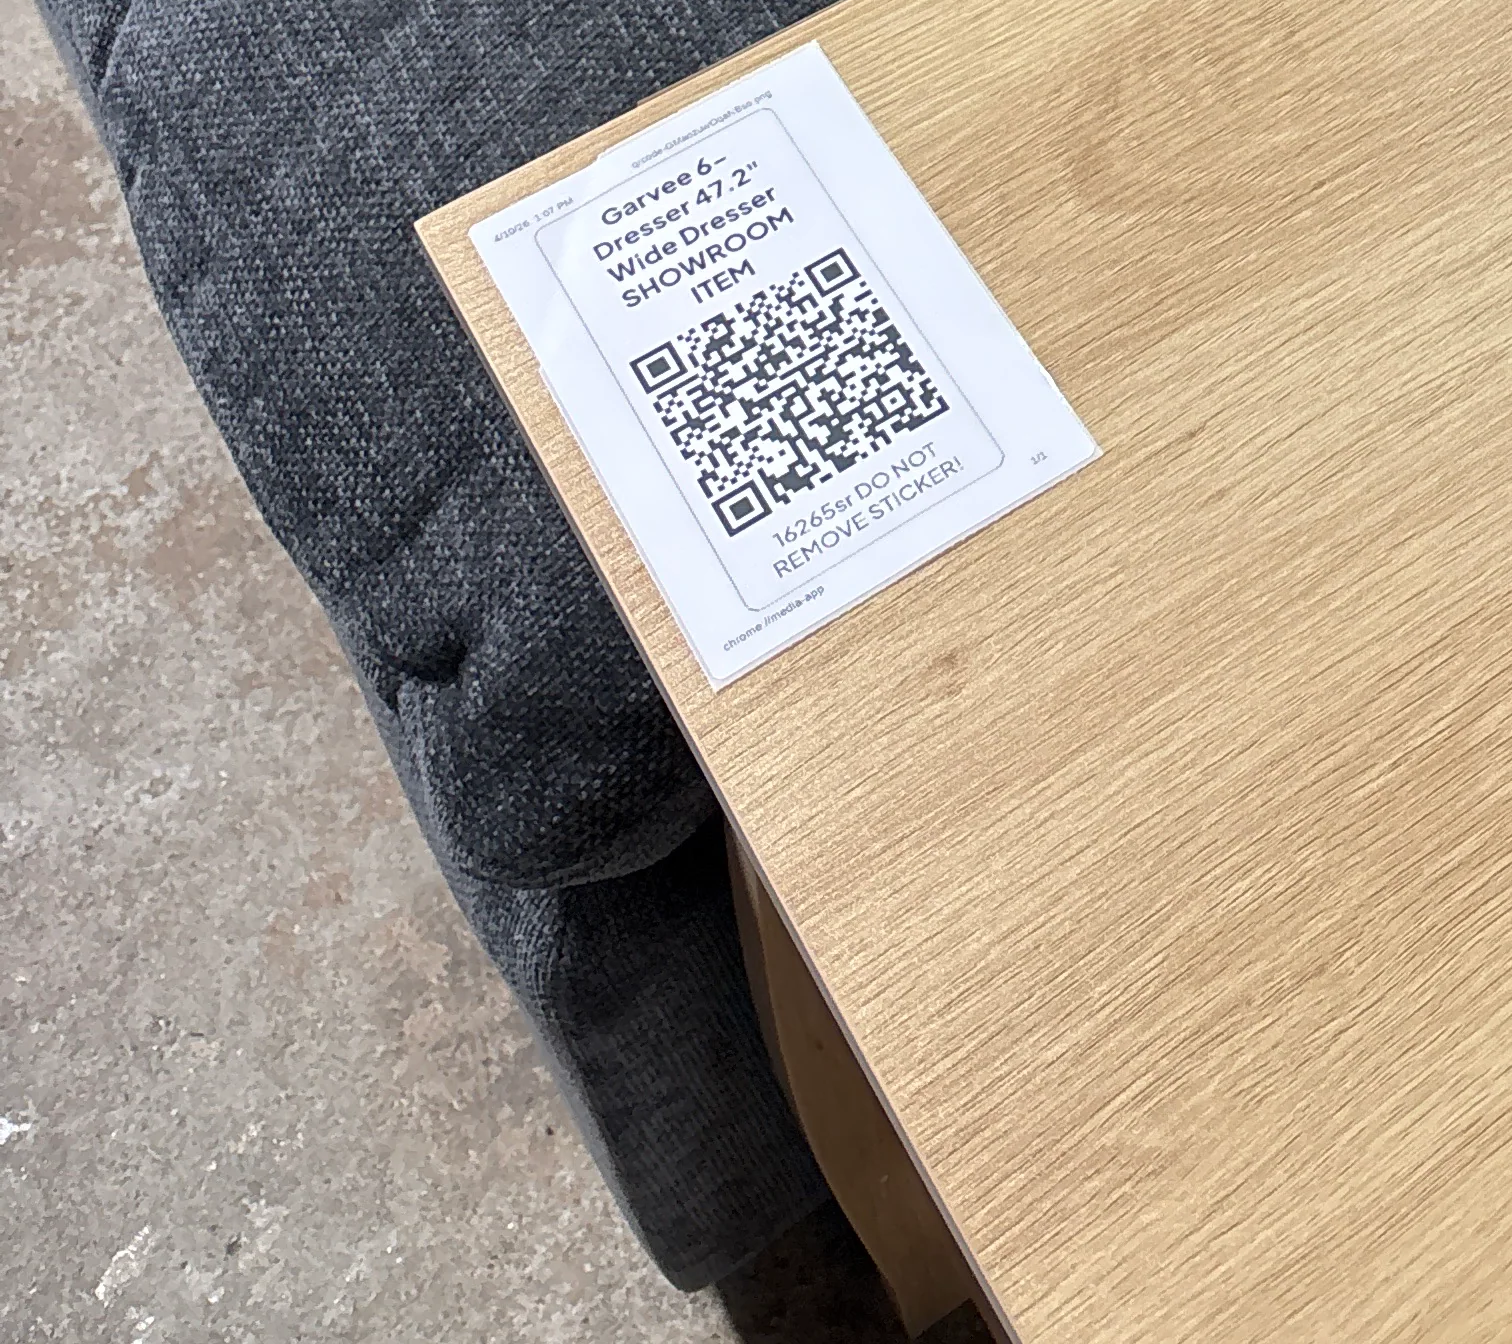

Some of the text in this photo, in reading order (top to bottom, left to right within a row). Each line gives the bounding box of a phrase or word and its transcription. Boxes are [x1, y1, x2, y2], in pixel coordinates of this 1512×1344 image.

[556, 196, 574, 210] PM
[593, 161, 758, 261] Dresser 47.2"
[601, 172, 693, 225] Garvee
[607, 188, 776, 282] Wide Dresser
[621, 207, 795, 308] SHOWROOM
[691, 259, 756, 303] ITEM
[772, 441, 937, 547] 16265sr DO NOT
[772, 456, 965, 578] REMOVE STICKER!
